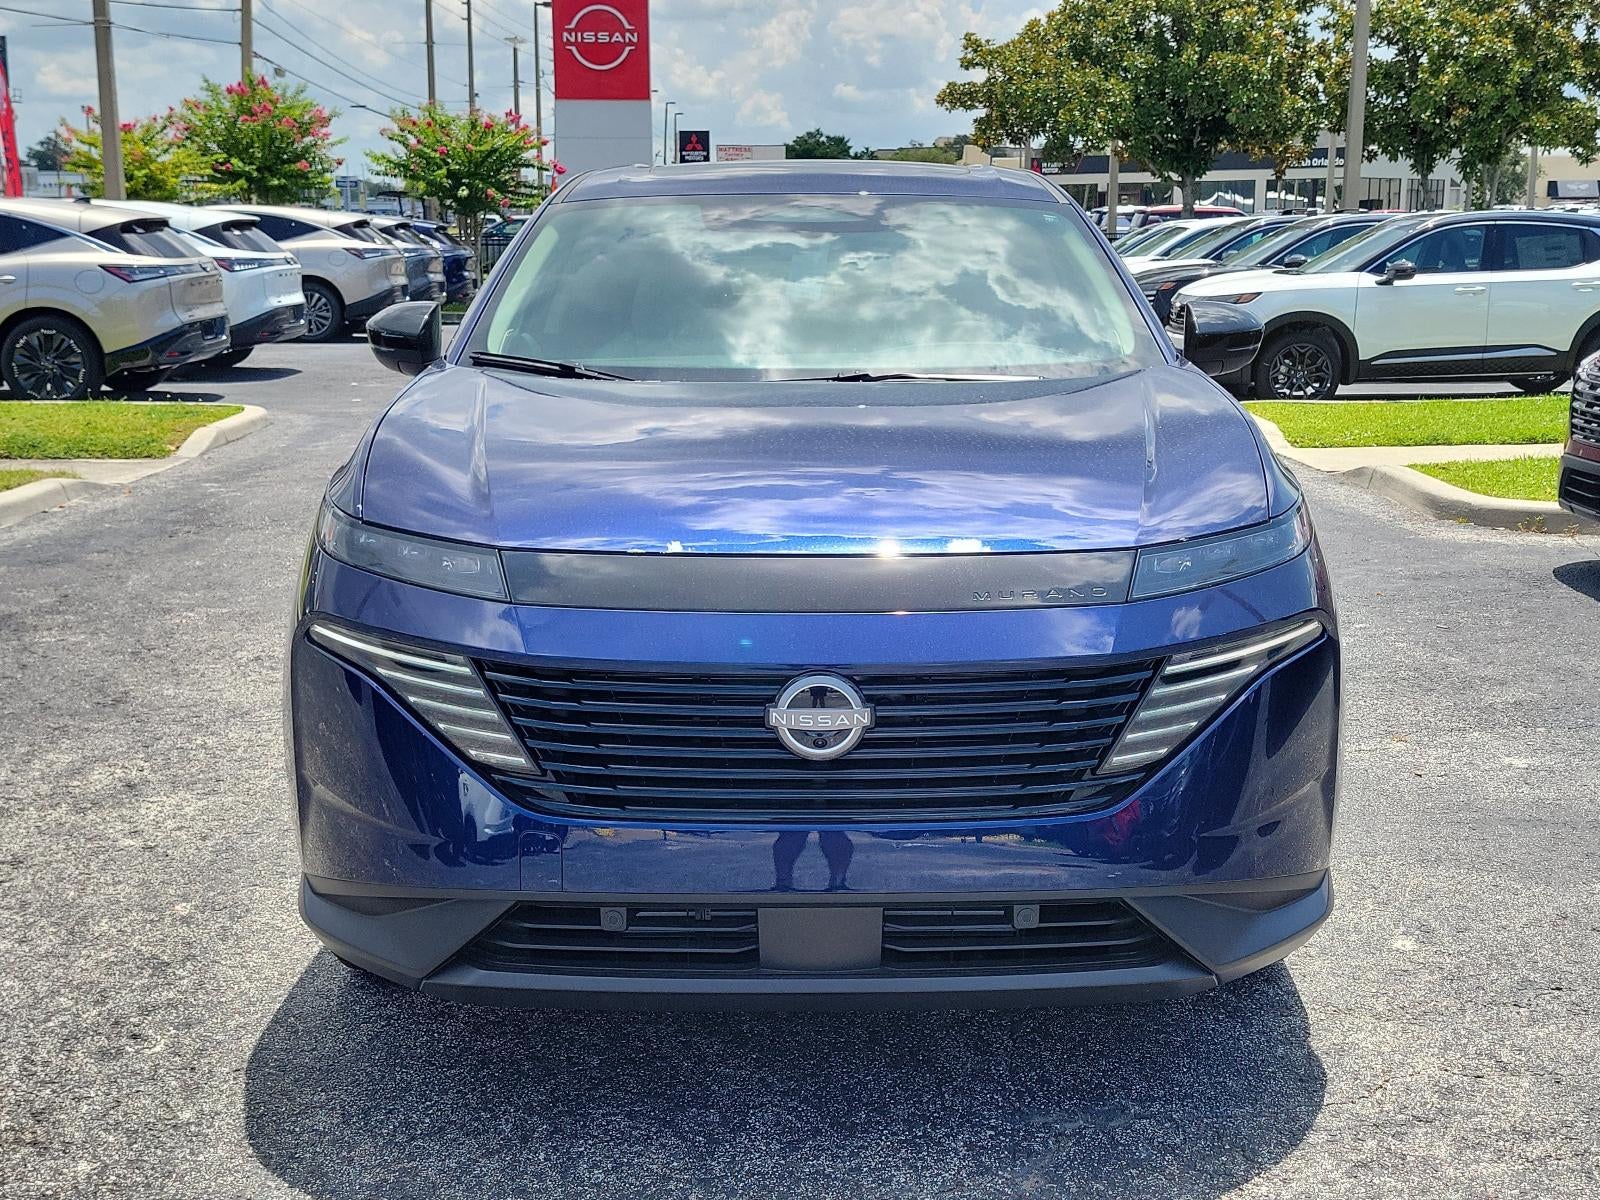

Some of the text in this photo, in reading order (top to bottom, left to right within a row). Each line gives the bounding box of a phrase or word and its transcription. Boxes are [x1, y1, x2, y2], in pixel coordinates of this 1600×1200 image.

[562, 31, 638, 43] NISSAN
[1312, 157, 1344, 166] Orlado
[972, 587, 1108, 601] MURANO
[772, 711, 868, 727] NISSAN
